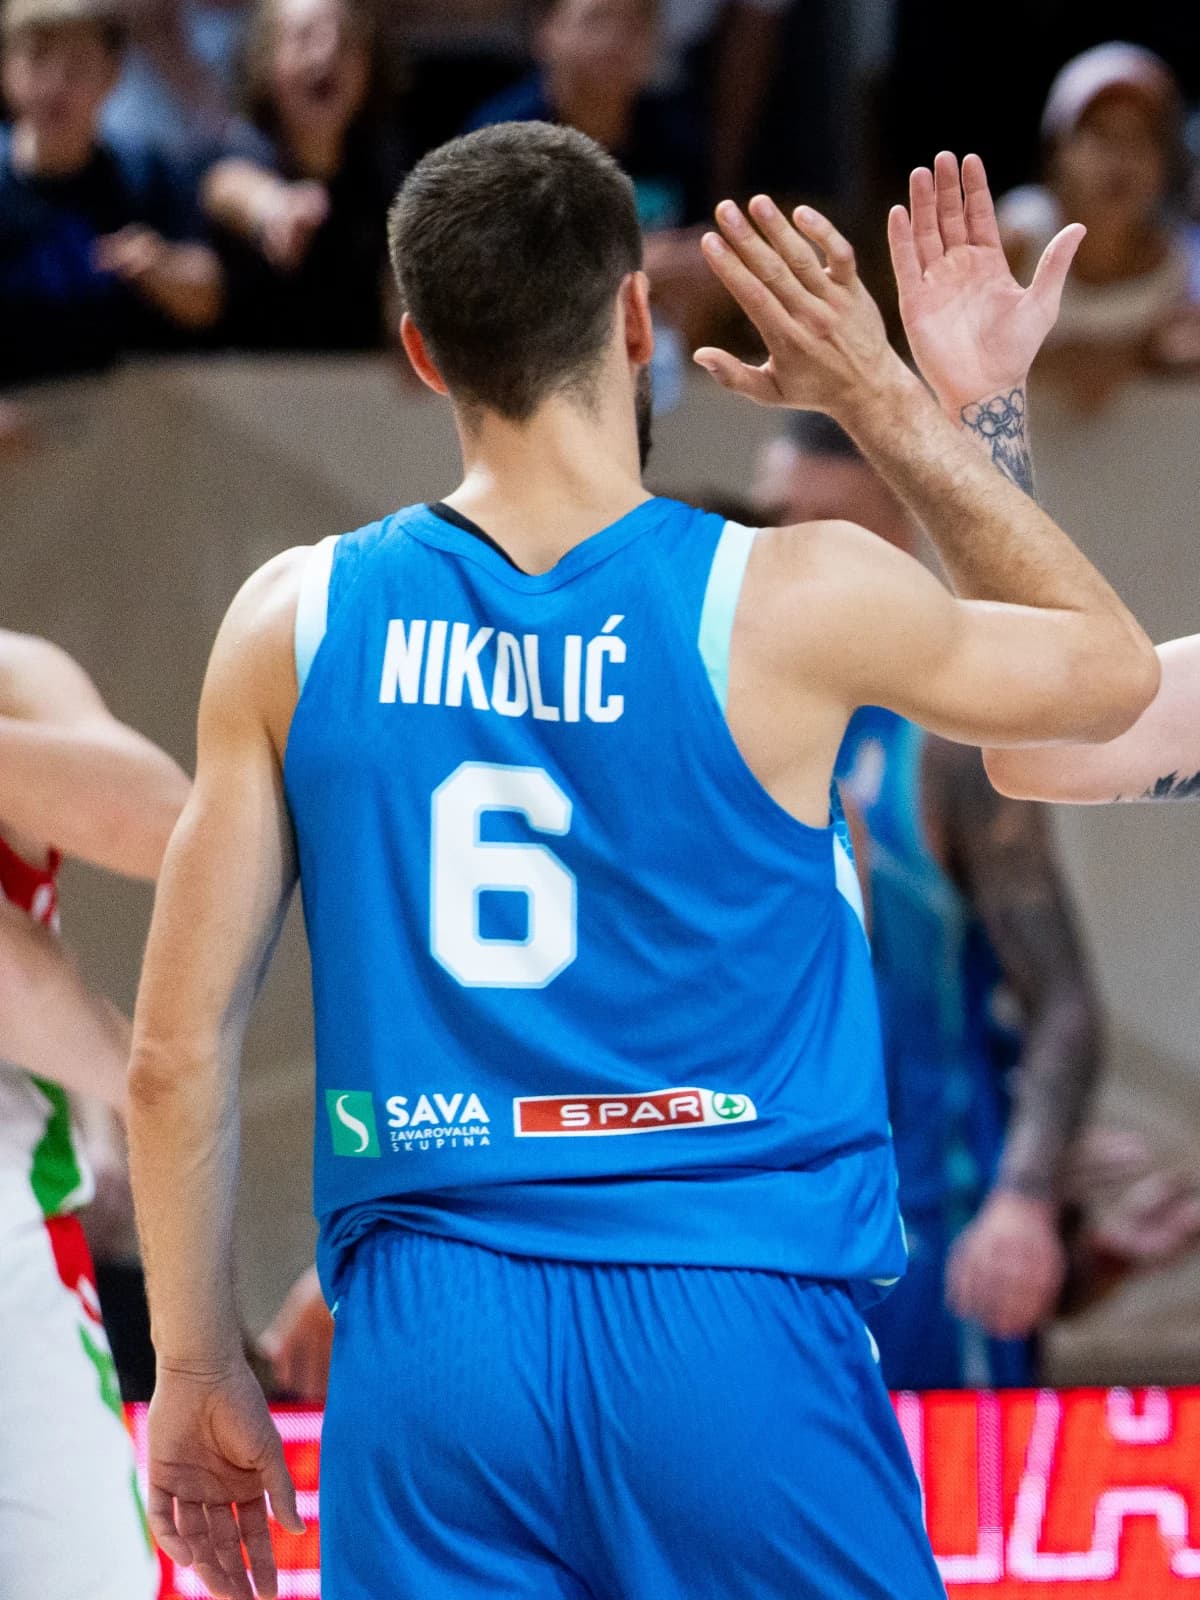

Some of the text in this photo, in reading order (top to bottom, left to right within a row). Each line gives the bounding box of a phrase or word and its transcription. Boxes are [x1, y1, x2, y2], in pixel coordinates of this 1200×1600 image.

[379, 615, 626, 724] NIKOLIĆ
[430, 761, 578, 989] 6
[386, 1093, 490, 1128] SAVA
[560, 1096, 701, 1127] SPAR
[390, 1126, 490, 1142] ZAVAROVALNA
[392, 1136, 490, 1152] SKUPINA
